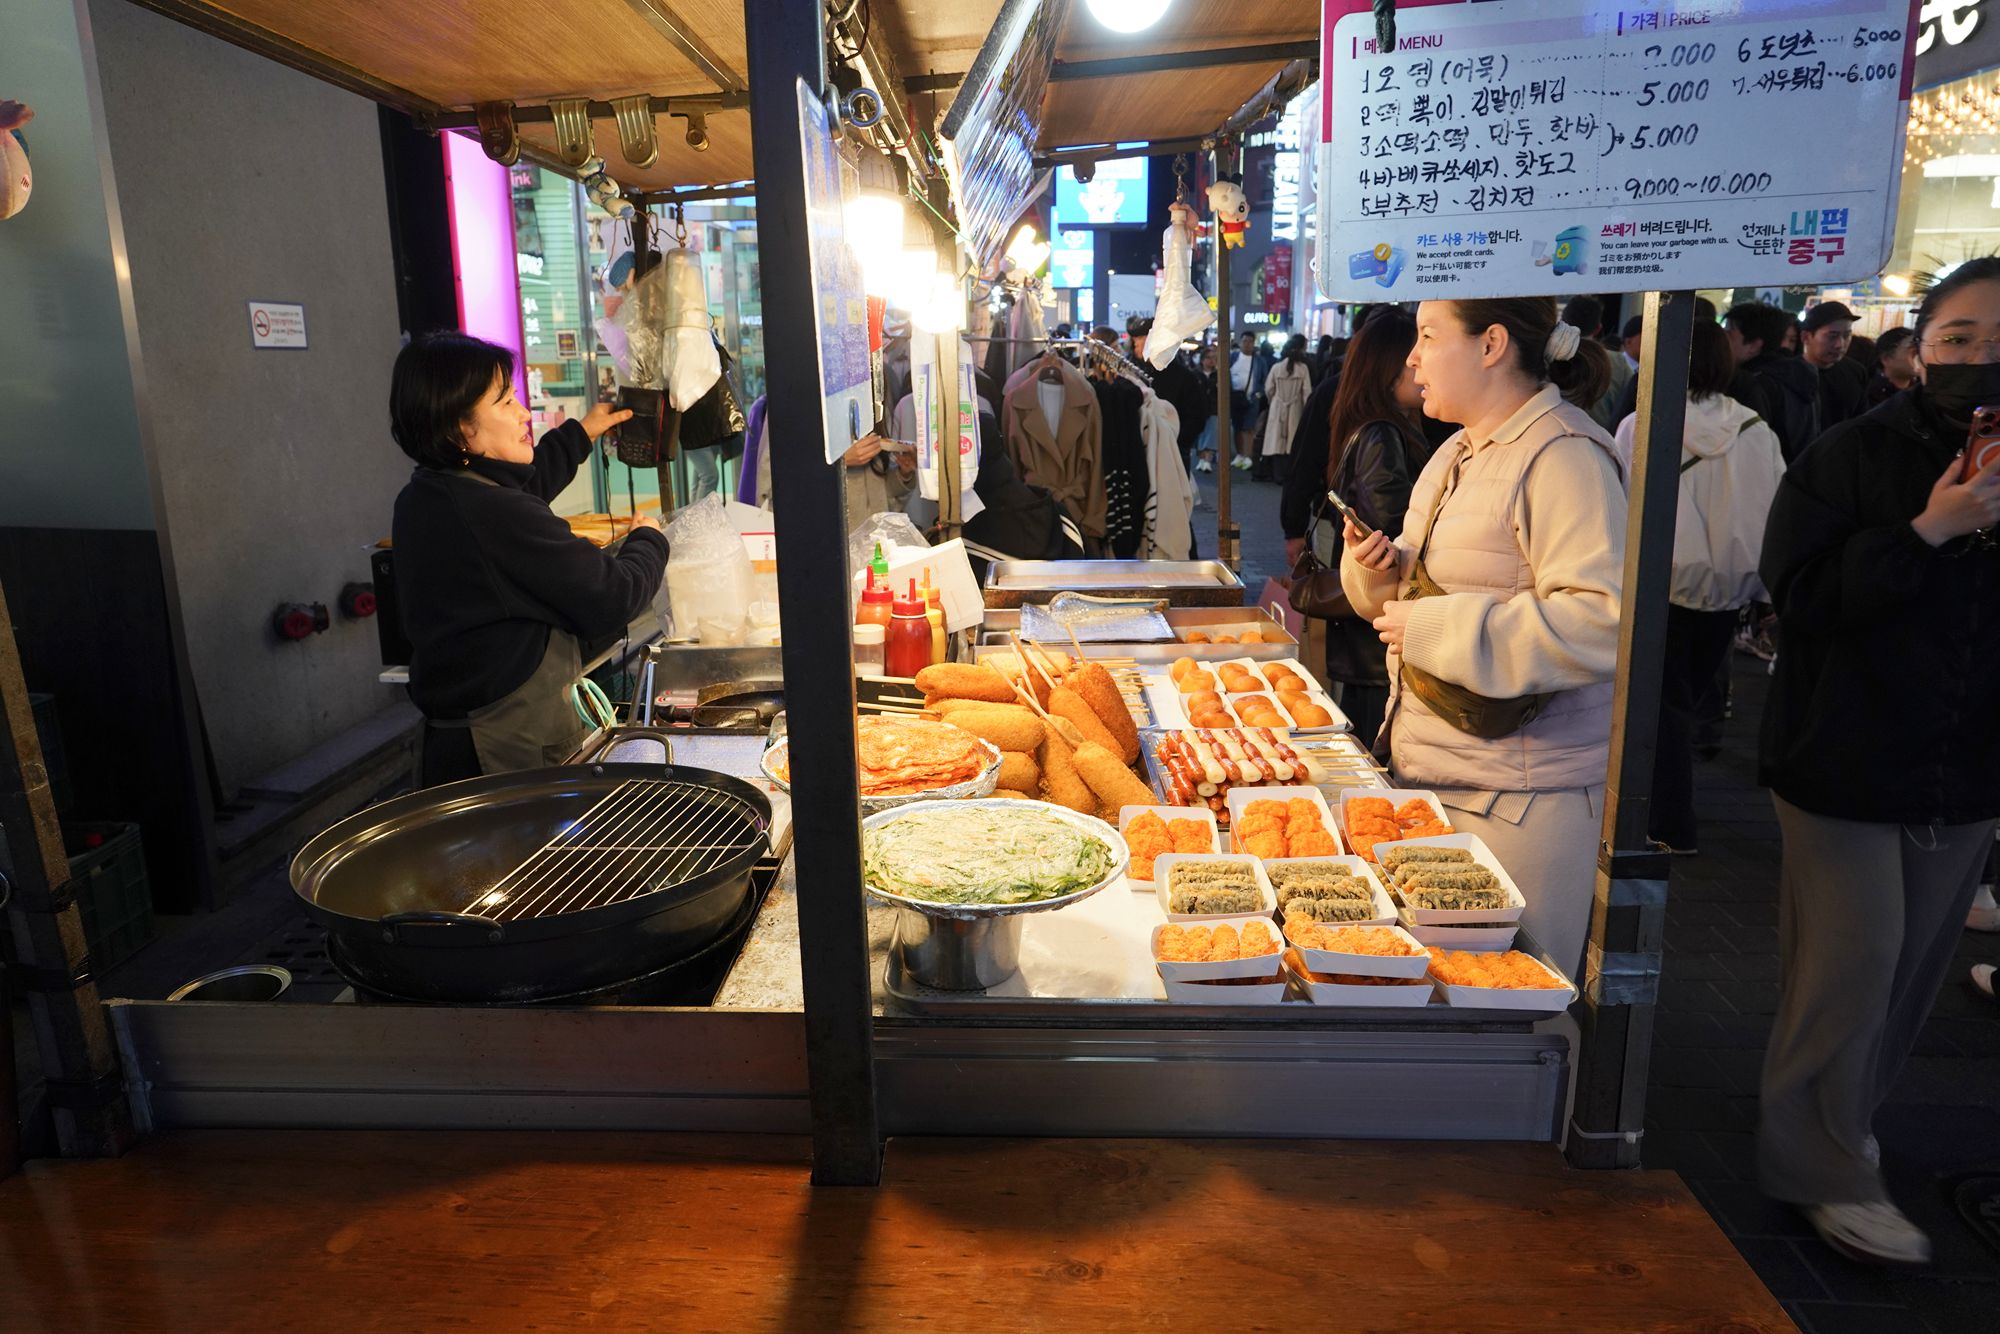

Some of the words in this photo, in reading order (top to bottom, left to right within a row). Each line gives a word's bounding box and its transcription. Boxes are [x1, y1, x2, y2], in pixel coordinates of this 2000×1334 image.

[1631, 11, 1659, 31] 가격
[1669, 9, 1710, 27] PRICE
[1399, 34, 1443, 51] MENU
[1738, 37, 1751, 63] 6
[1636, 79, 1710, 107] 5.000
[1630, 123, 1699, 150] 5.000
[1515, 150, 1577, 179] 핫도그
[1271, 152, 1300, 242] BEAUTY
[1600, 221, 1637, 237] 쓰레기
[1640, 217, 1713, 236] 버려드립니다.
[1742, 222, 1787, 239] 언제나
[1789, 207, 1849, 236] 내편
[1417, 233, 1439, 248] 카드
[1441, 231, 1464, 247] 사용
[1466, 228, 1523, 246] 가능합니다.
[1600, 241, 1614, 251] You
[1615, 241, 1629, 250] can
[1630, 240, 1650, 250] leave
[1651, 240, 1668, 250] your
[1669, 238, 1699, 249] garbage
[1700, 236, 1718, 245] with
[1752, 237, 1785, 256] 든든한
[1416, 250, 1428, 260] We
[1428, 249, 1452, 261] accept
[1453, 247, 1473, 258] credit
[1787, 237, 1845, 266] 중구
